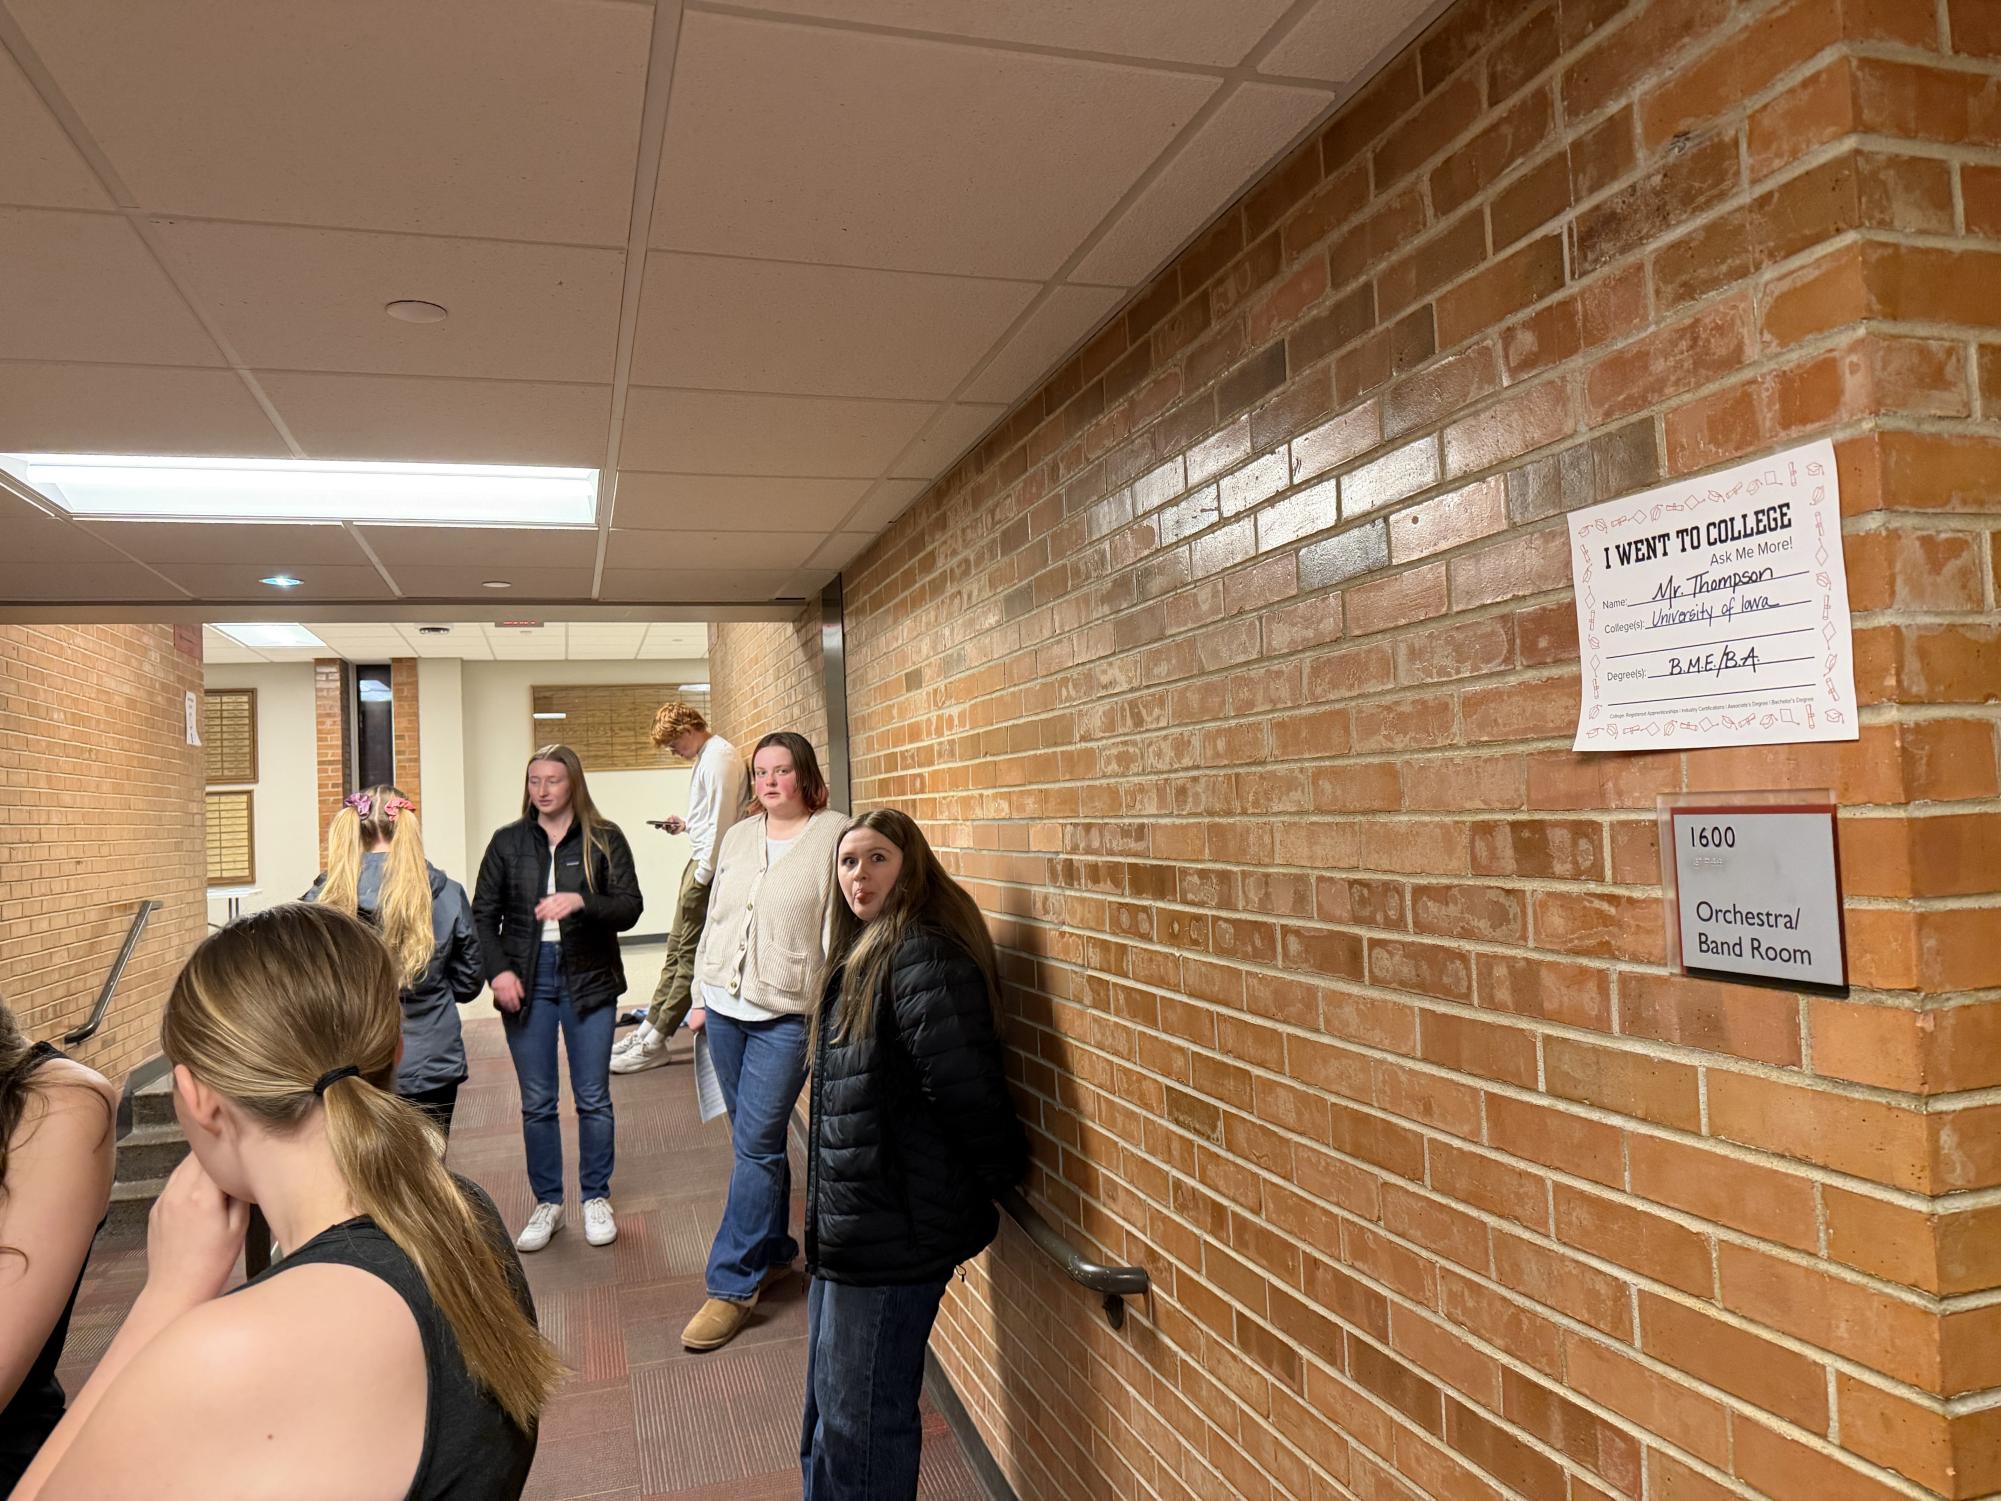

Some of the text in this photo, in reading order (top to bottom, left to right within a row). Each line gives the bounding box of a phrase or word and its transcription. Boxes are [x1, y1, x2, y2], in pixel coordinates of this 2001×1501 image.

[1604, 502, 1792, 569] I WENT TO COLLEGE
[1710, 536, 1793, 566] Ask Me More!
[1652, 567, 1773, 609] Mr. Thompson
[1602, 599, 1628, 609] Name:
[1652, 595, 1780, 627] University of Iowa
[1604, 620, 1645, 634] College(s):
[1607, 670, 1647, 681] Degree(s):
[1691, 826, 1735, 848] 1600
[1696, 901, 1800, 930] Orchestra/
[1698, 932, 1812, 965] Band Room
